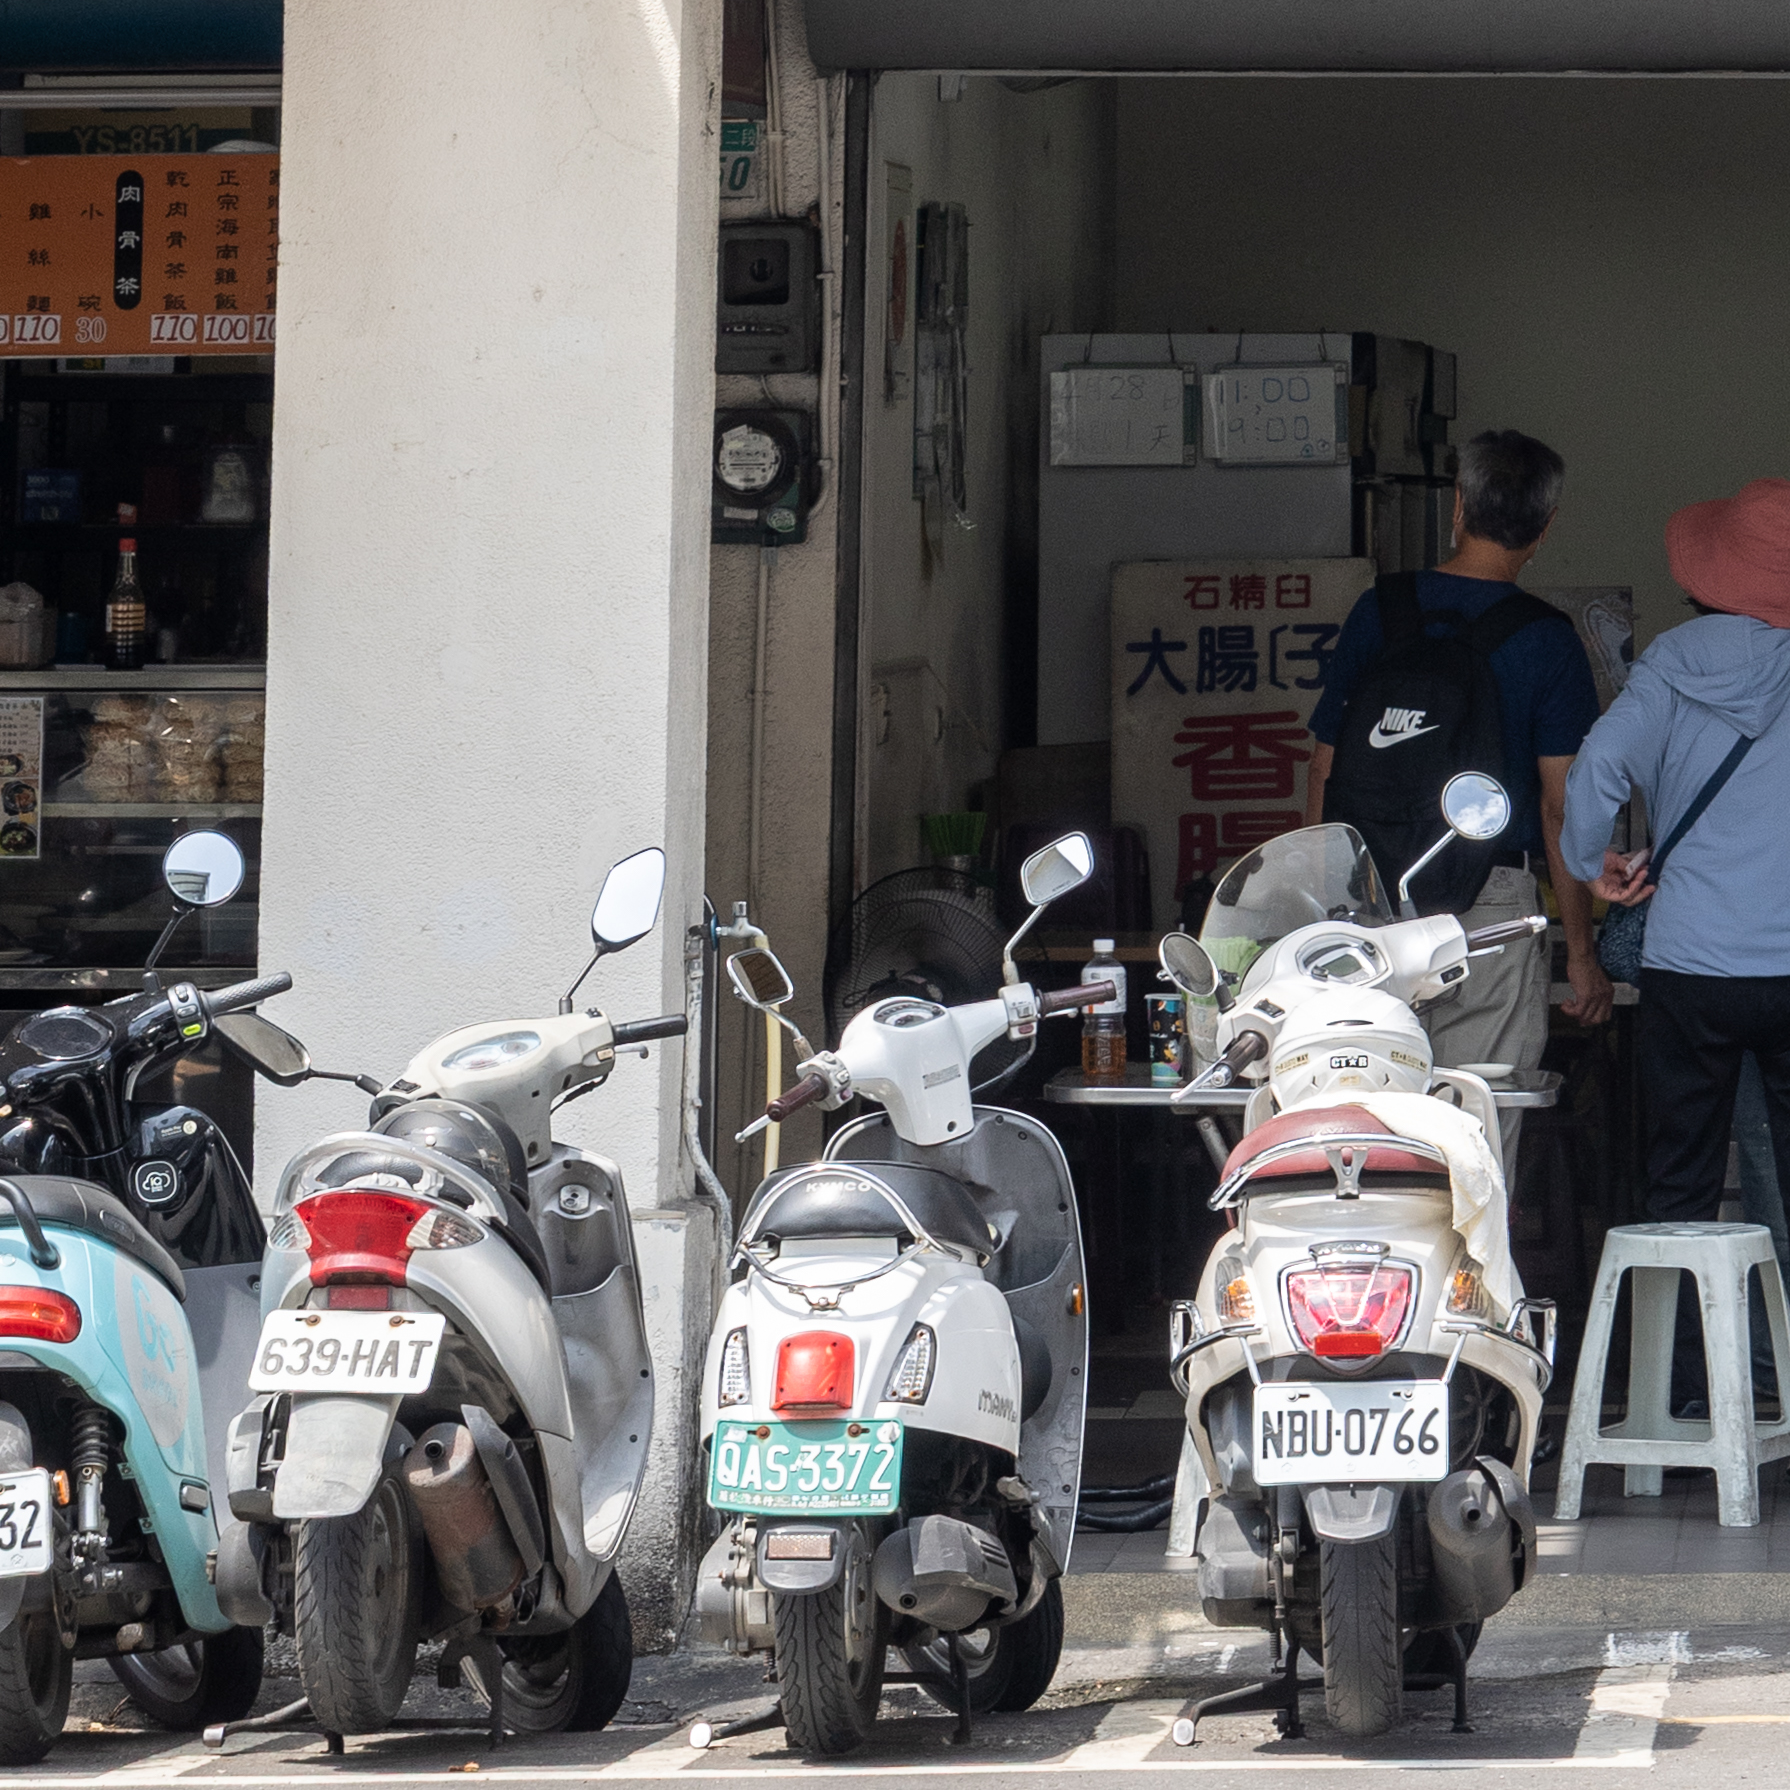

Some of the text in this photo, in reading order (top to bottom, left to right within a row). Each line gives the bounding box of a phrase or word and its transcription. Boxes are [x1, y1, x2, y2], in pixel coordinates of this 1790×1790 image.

[116, 184, 141, 296] 肉骨茶
[163, 170, 190, 312] 乾肉骨茶飯
[213, 169, 241, 311] 正宗海南雞飯
[15, 315, 59, 343] 110
[75, 316, 107, 343] 30
[152, 315, 198, 342] 110
[204, 315, 249, 343] 100
[1183, 573, 1312, 611] 石精臼
[1381, 706, 1427, 733] NIKE
[806, 1180, 871, 1193] KYMCO
